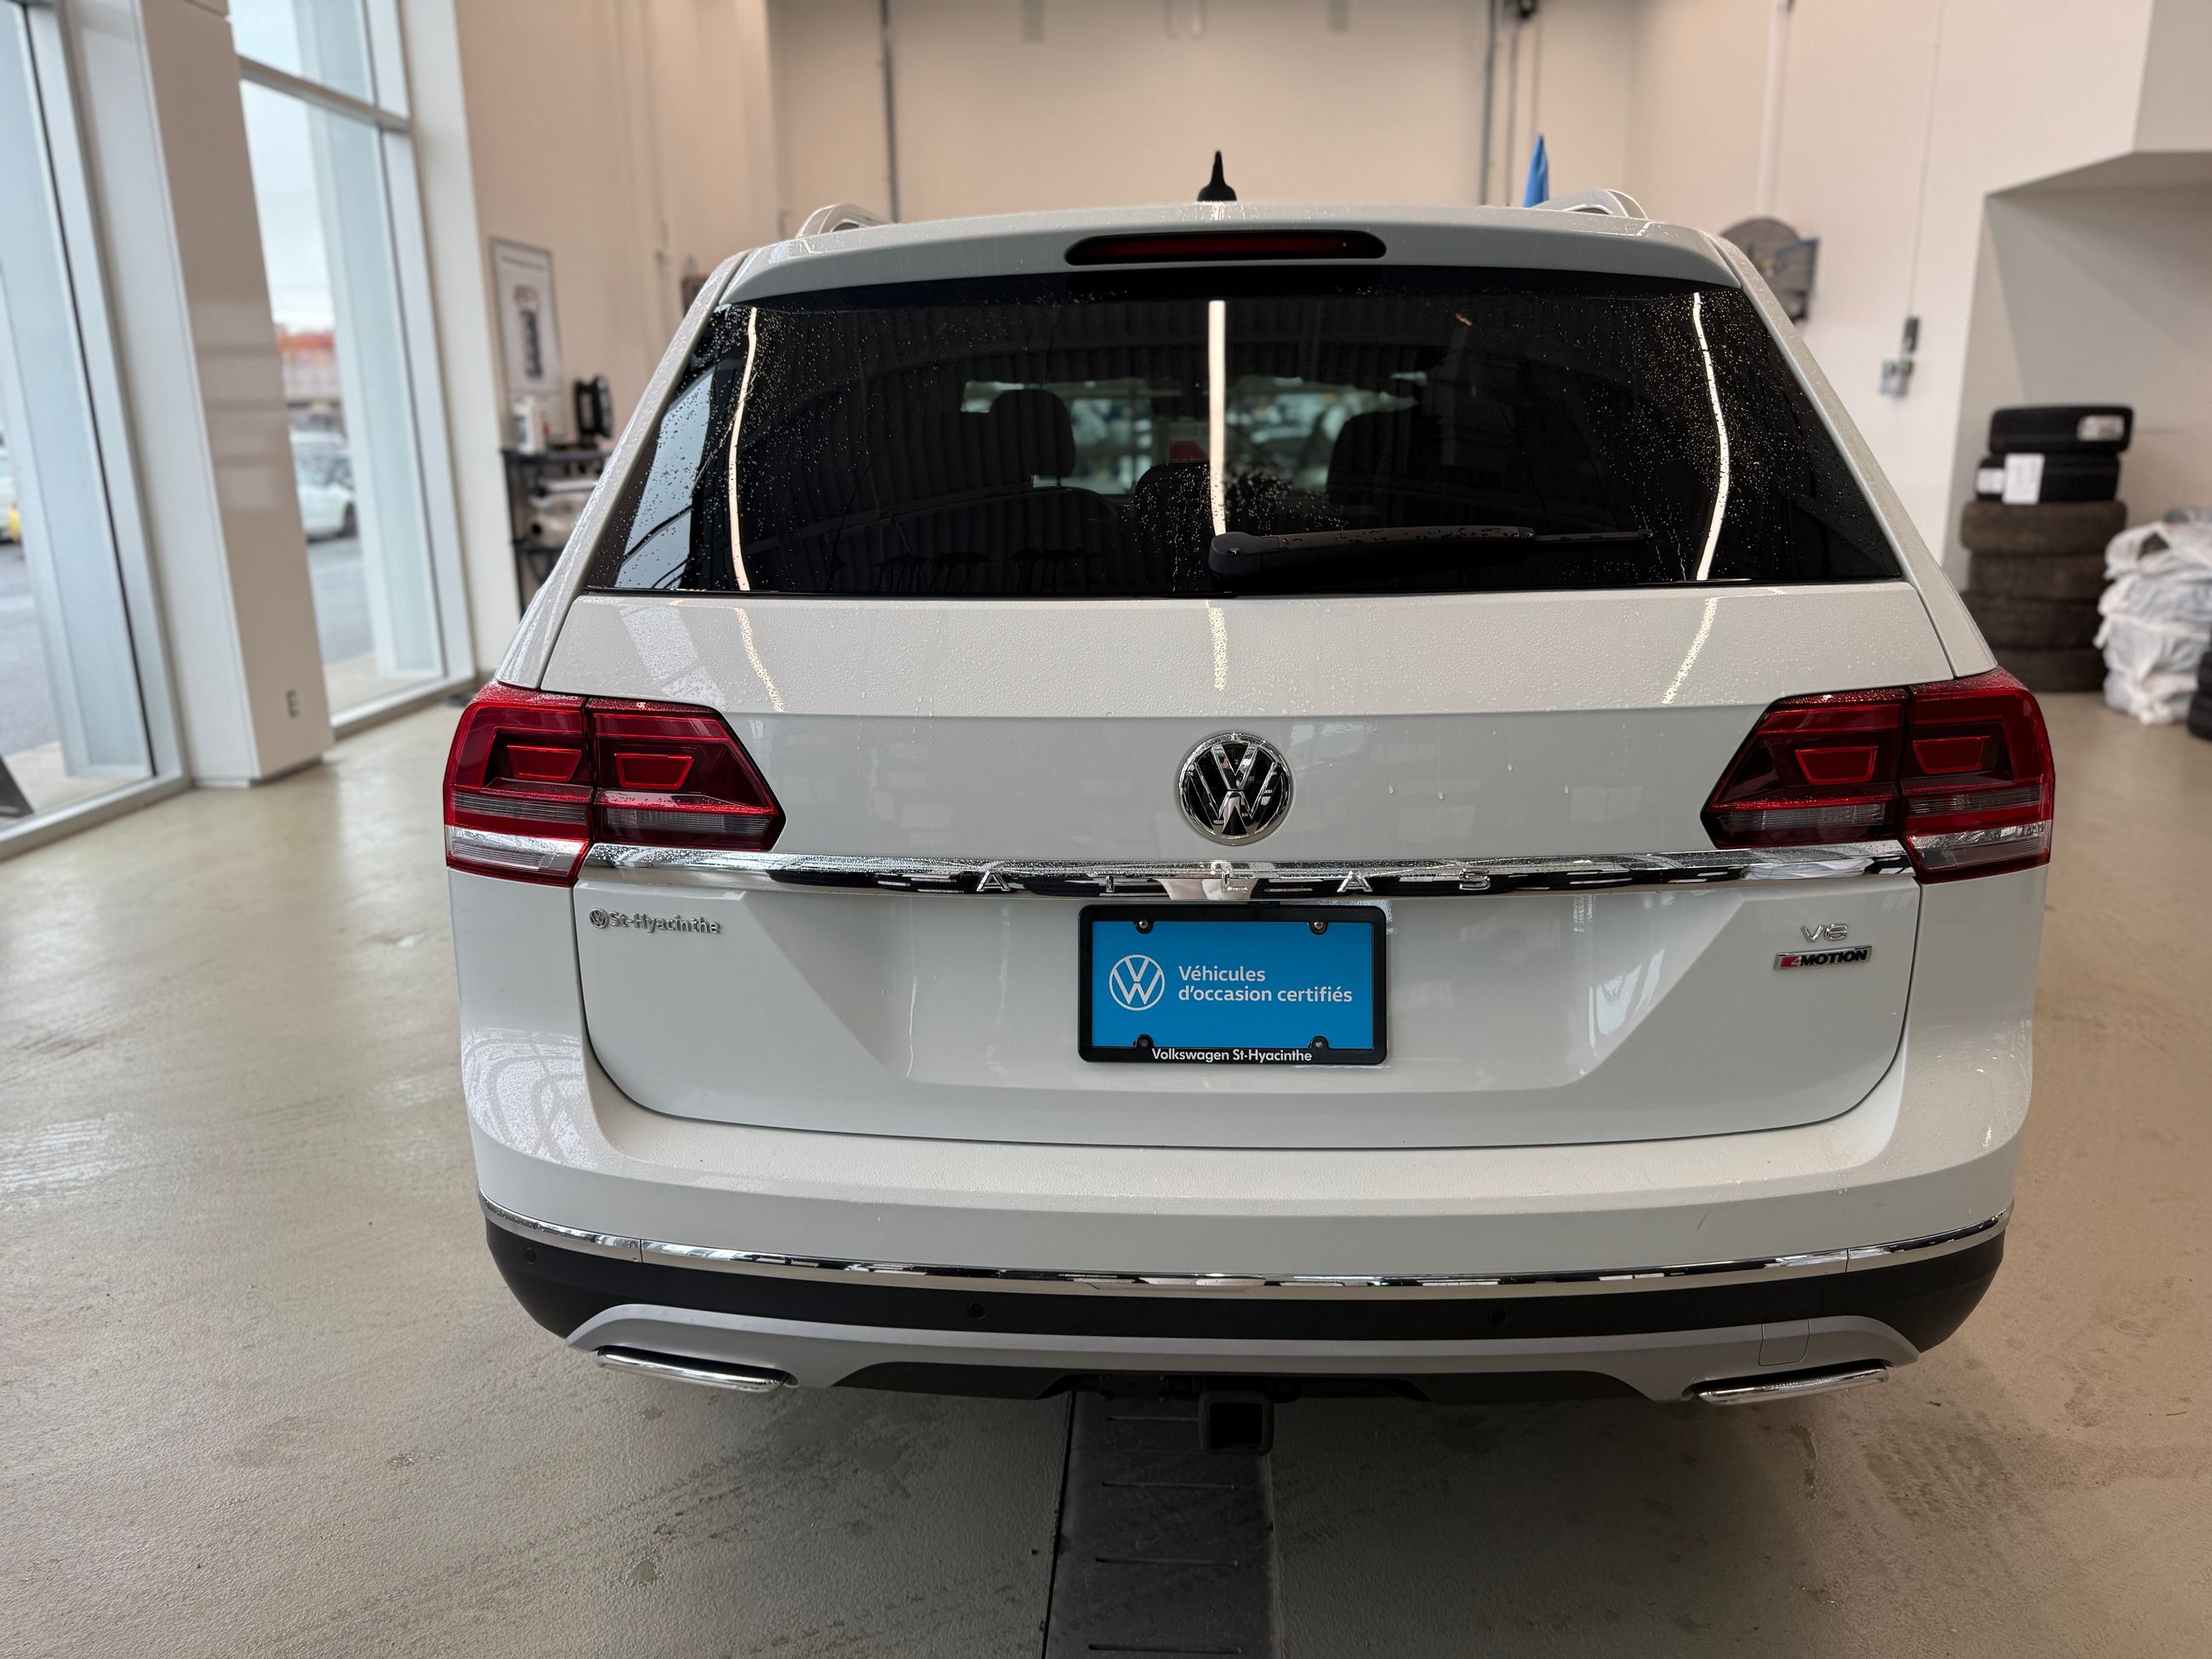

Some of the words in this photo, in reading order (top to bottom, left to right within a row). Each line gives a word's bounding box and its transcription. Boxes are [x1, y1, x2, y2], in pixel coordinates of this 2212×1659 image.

[609, 910, 721, 934] St-Hyacinthe
[1800, 923, 1849, 944] V6
[1781, 949, 1868, 967] 4MOTION
[1178, 966, 1266, 982] Véhicules
[1277, 986, 1353, 1003] certifiés
[1151, 1048, 1229, 1063] Volkswagen
[1233, 1049, 1313, 1063] St-Hyacinthe
